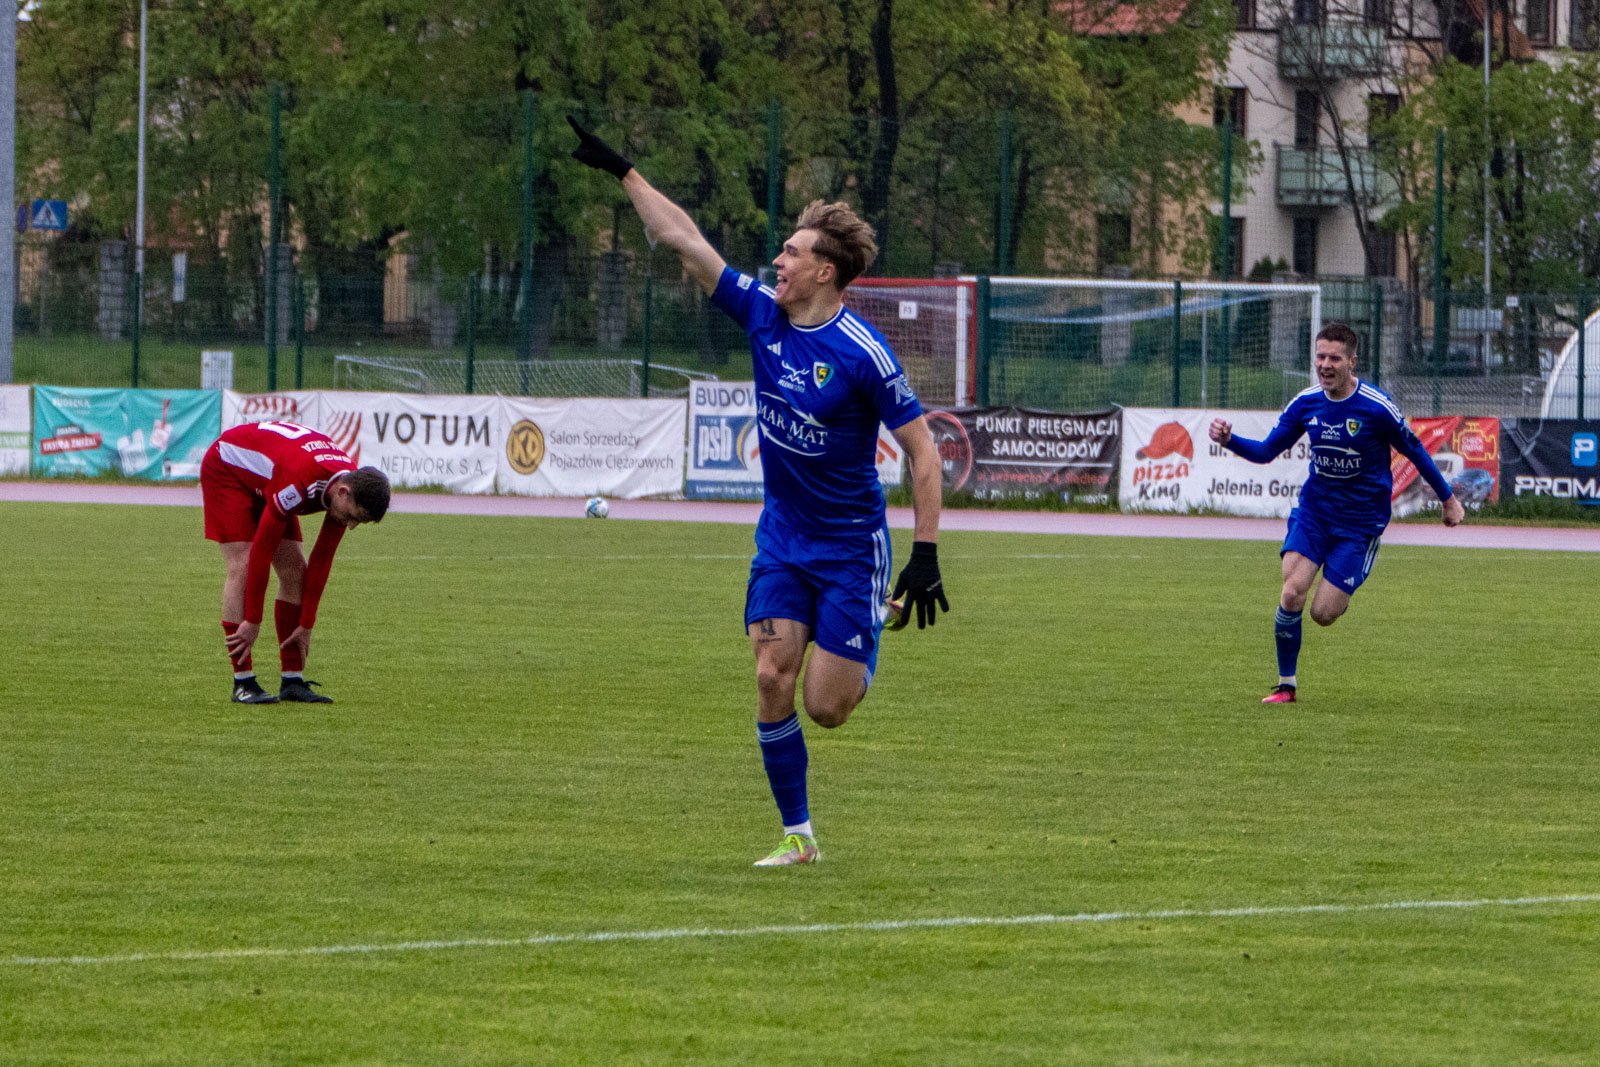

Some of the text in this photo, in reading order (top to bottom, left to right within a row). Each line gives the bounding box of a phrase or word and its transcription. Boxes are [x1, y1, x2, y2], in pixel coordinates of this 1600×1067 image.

[373, 412, 490, 447] VOTUM
[975, 416, 1119, 439] PUNKT PIELĘGNACJI
[550, 430, 641, 450] Salon Sprzedaży
[697, 418, 733, 467] psb
[992, 438, 1102, 459] SAMOCHODÓW
[1209, 443, 1228, 458] ul.
[381, 455, 454, 475] NETWORK
[550, 454, 674, 473] Pojazdów Ciężarowych
[1132, 462, 1190, 487] pizza
[1138, 482, 1181, 501] King
[1207, 478, 1263, 497] Jelenia
